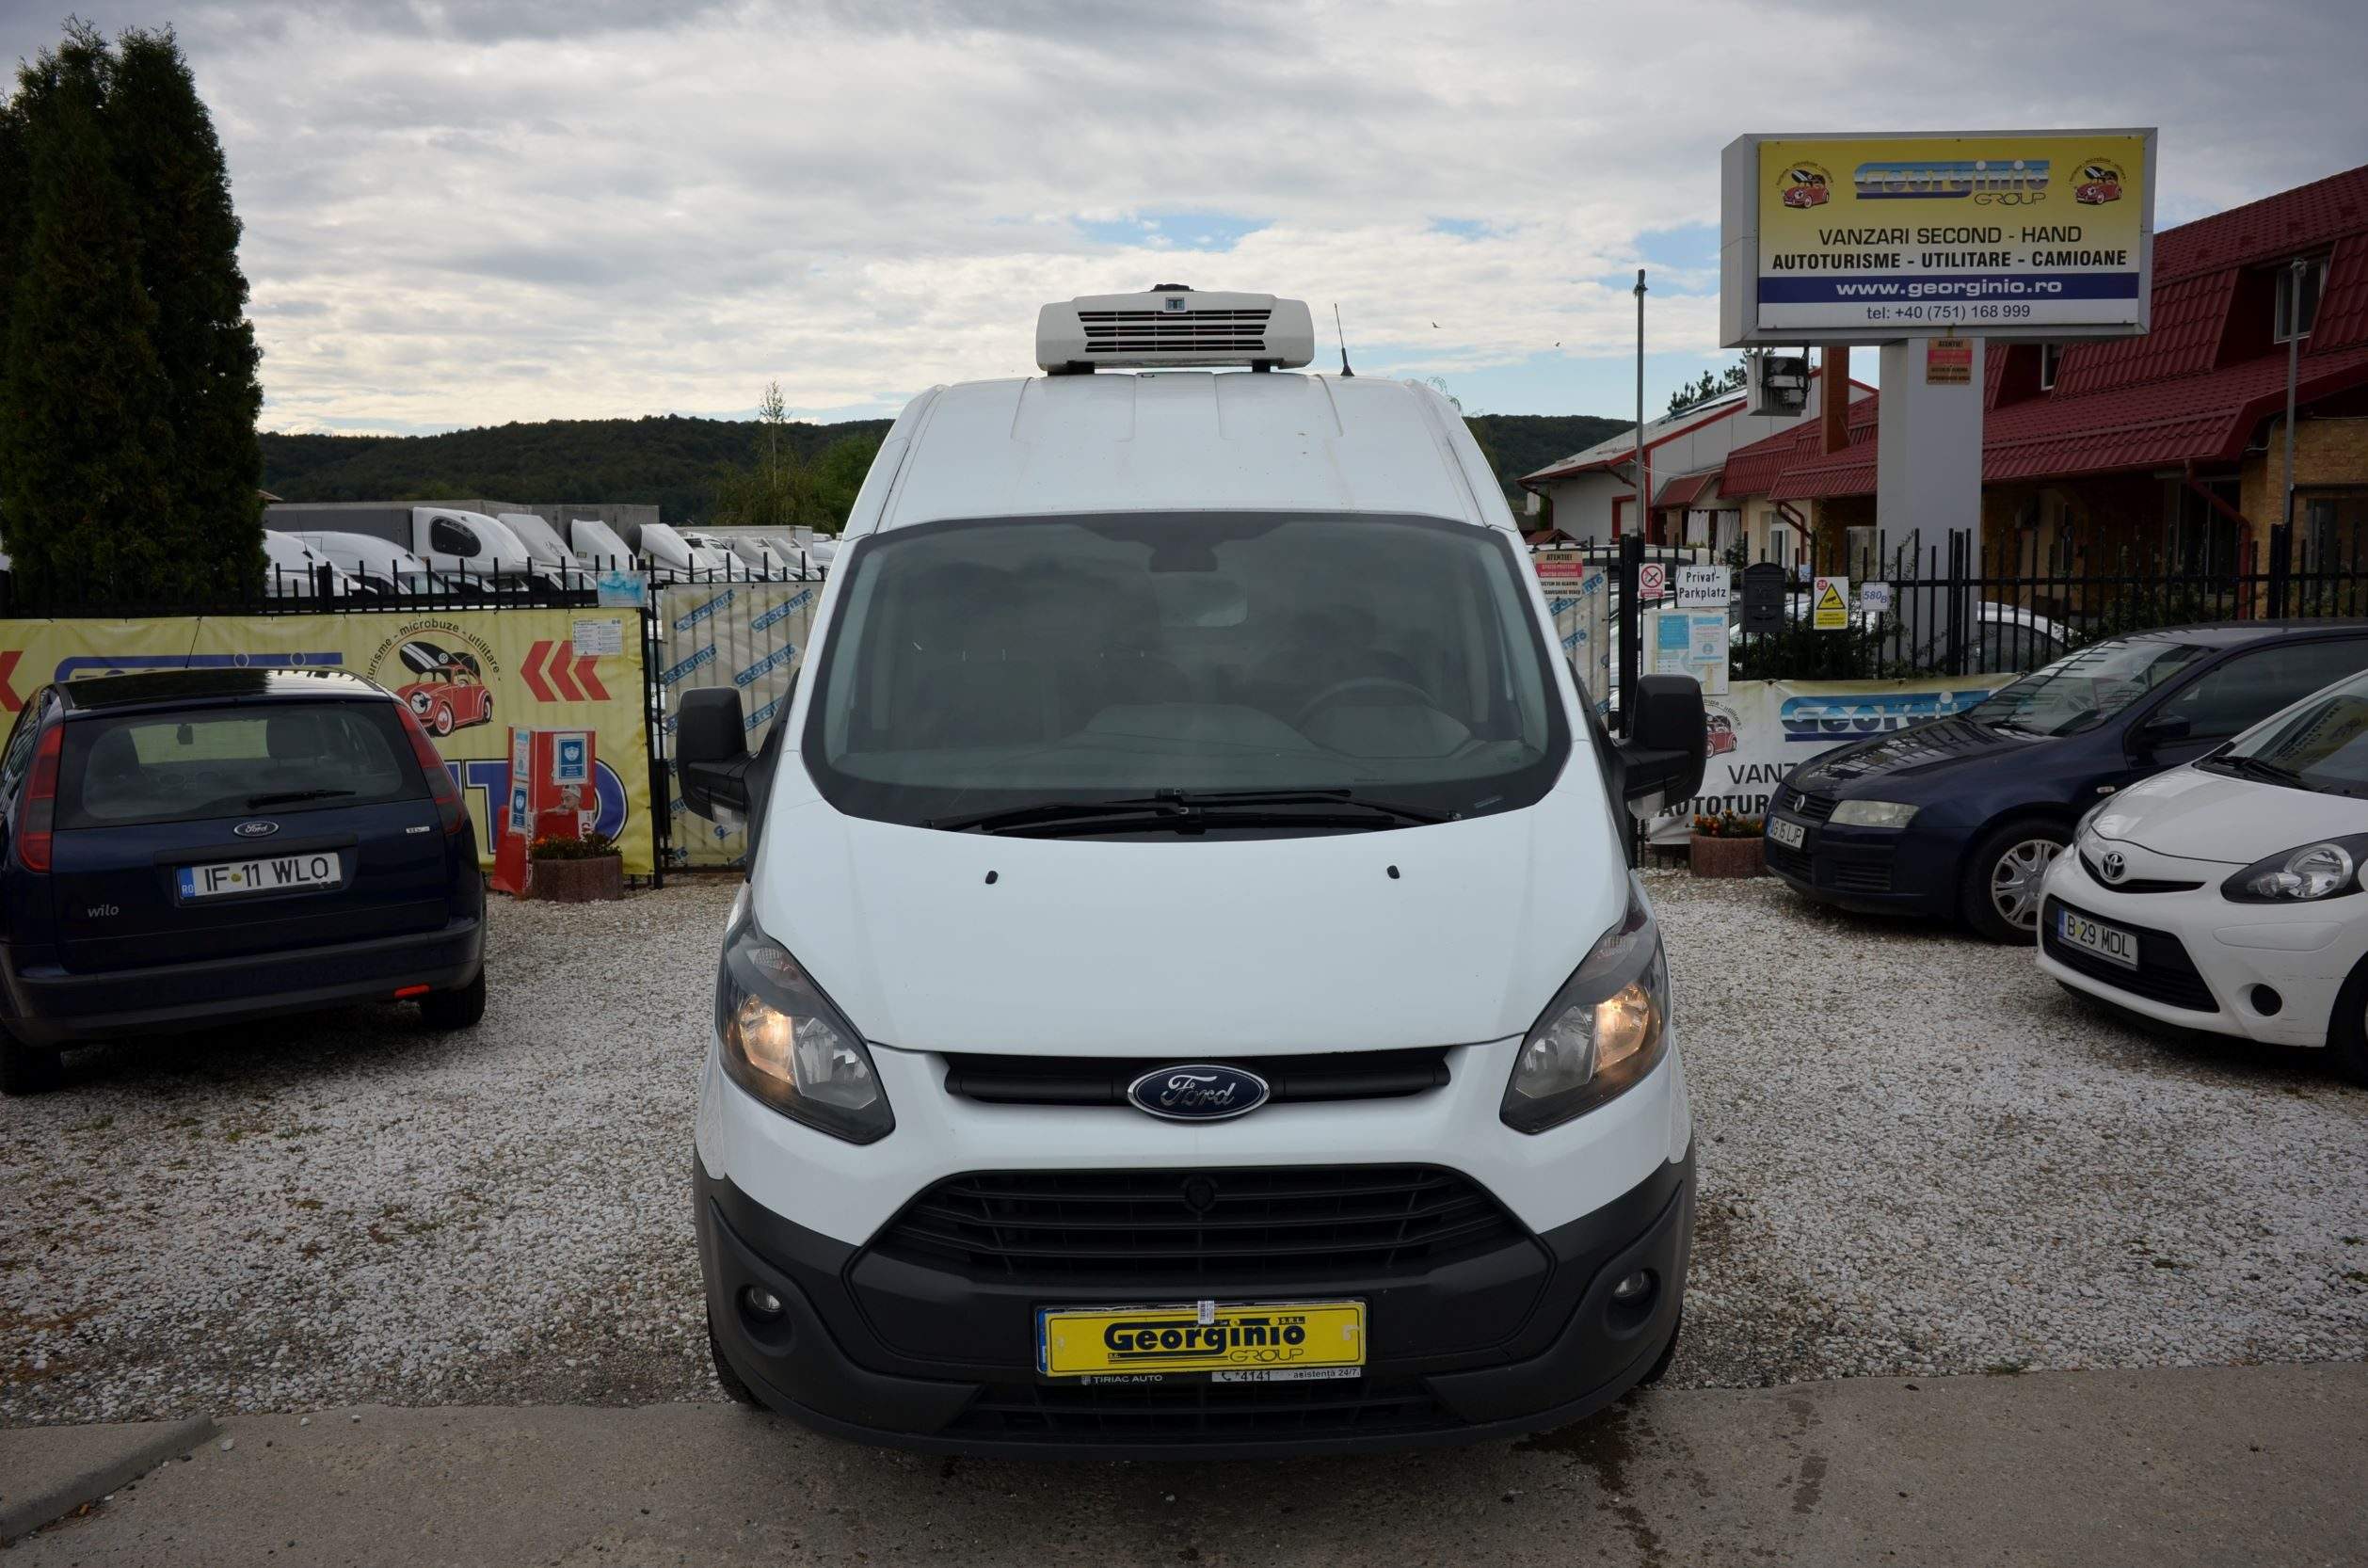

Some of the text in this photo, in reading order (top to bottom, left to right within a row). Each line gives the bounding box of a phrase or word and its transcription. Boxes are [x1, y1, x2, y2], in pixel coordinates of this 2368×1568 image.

[1974, 191, 2046, 206] GROUP
[1818, 228, 1910, 246] VANZARI
[1916, 227, 2002, 245] SECOND
[2022, 225, 2083, 243] HAND
[1771, 252, 1901, 270] AUTOTURISME
[1921, 251, 2012, 268] UTILITARE
[2031, 249, 2127, 266] CAMIOANE
[1835, 280, 2063, 297] www.georginio.ro
[1866, 304, 2031, 323] tel: +40 (751) 168 999
[1686, 570, 1720, 584] Privat-
[1678, 586, 1727, 601] Parkplatz
[399, 617, 459, 636] microbuze
[468, 632, 500, 674] utilitare
[204, 856, 329, 891] IF 11 WLO
[87, 904, 120, 918] wilo
[2067, 915, 2131, 958] B 29 MDL
[1103, 1317, 1306, 1355] Georginio
[1229, 1348, 1304, 1363] GROUP
[1131, 1374, 1163, 1383] AUTO
